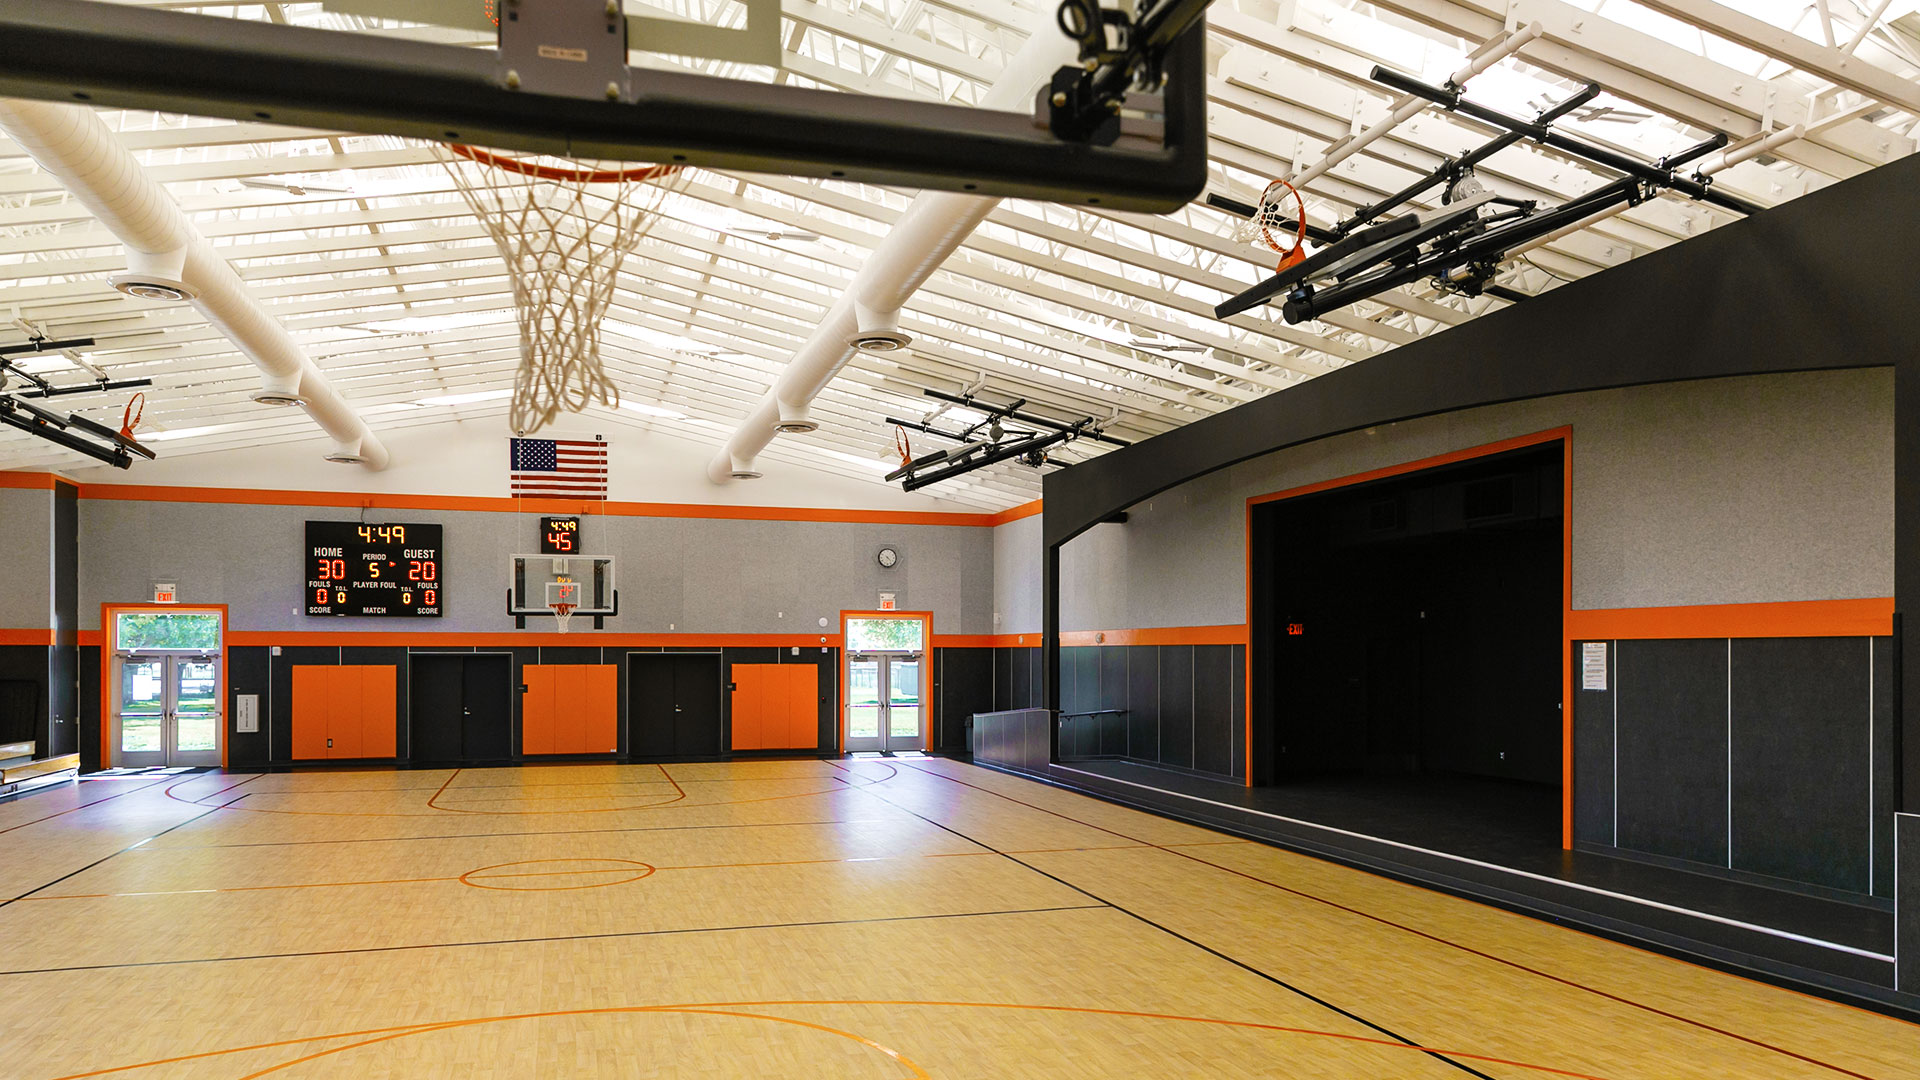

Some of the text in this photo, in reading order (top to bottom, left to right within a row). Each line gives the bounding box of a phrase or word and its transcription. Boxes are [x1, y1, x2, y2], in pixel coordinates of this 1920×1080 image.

[551, 521, 576, 531] 4:49
[358, 525, 405, 544] 4:49
[548, 532, 572, 550] 45
[314, 547, 343, 557] HOME
[362, 553, 387, 561] PERIOD
[403, 549, 435, 559] GUEST
[318, 559, 345, 580] 30
[369, 562, 380, 578] 5
[409, 561, 436, 581] 20
[308, 580, 331, 588] FOULS
[353, 581, 379, 589] PLAYER
[158, 592, 172, 601] EXIT
[316, 588, 328, 605] 0
[337, 591, 346, 604] 0
[402, 592, 411, 605] 0
[424, 589, 435, 605] 0
[309, 606, 331, 614] SCORE
[1289, 624, 1303, 635] EXIT
